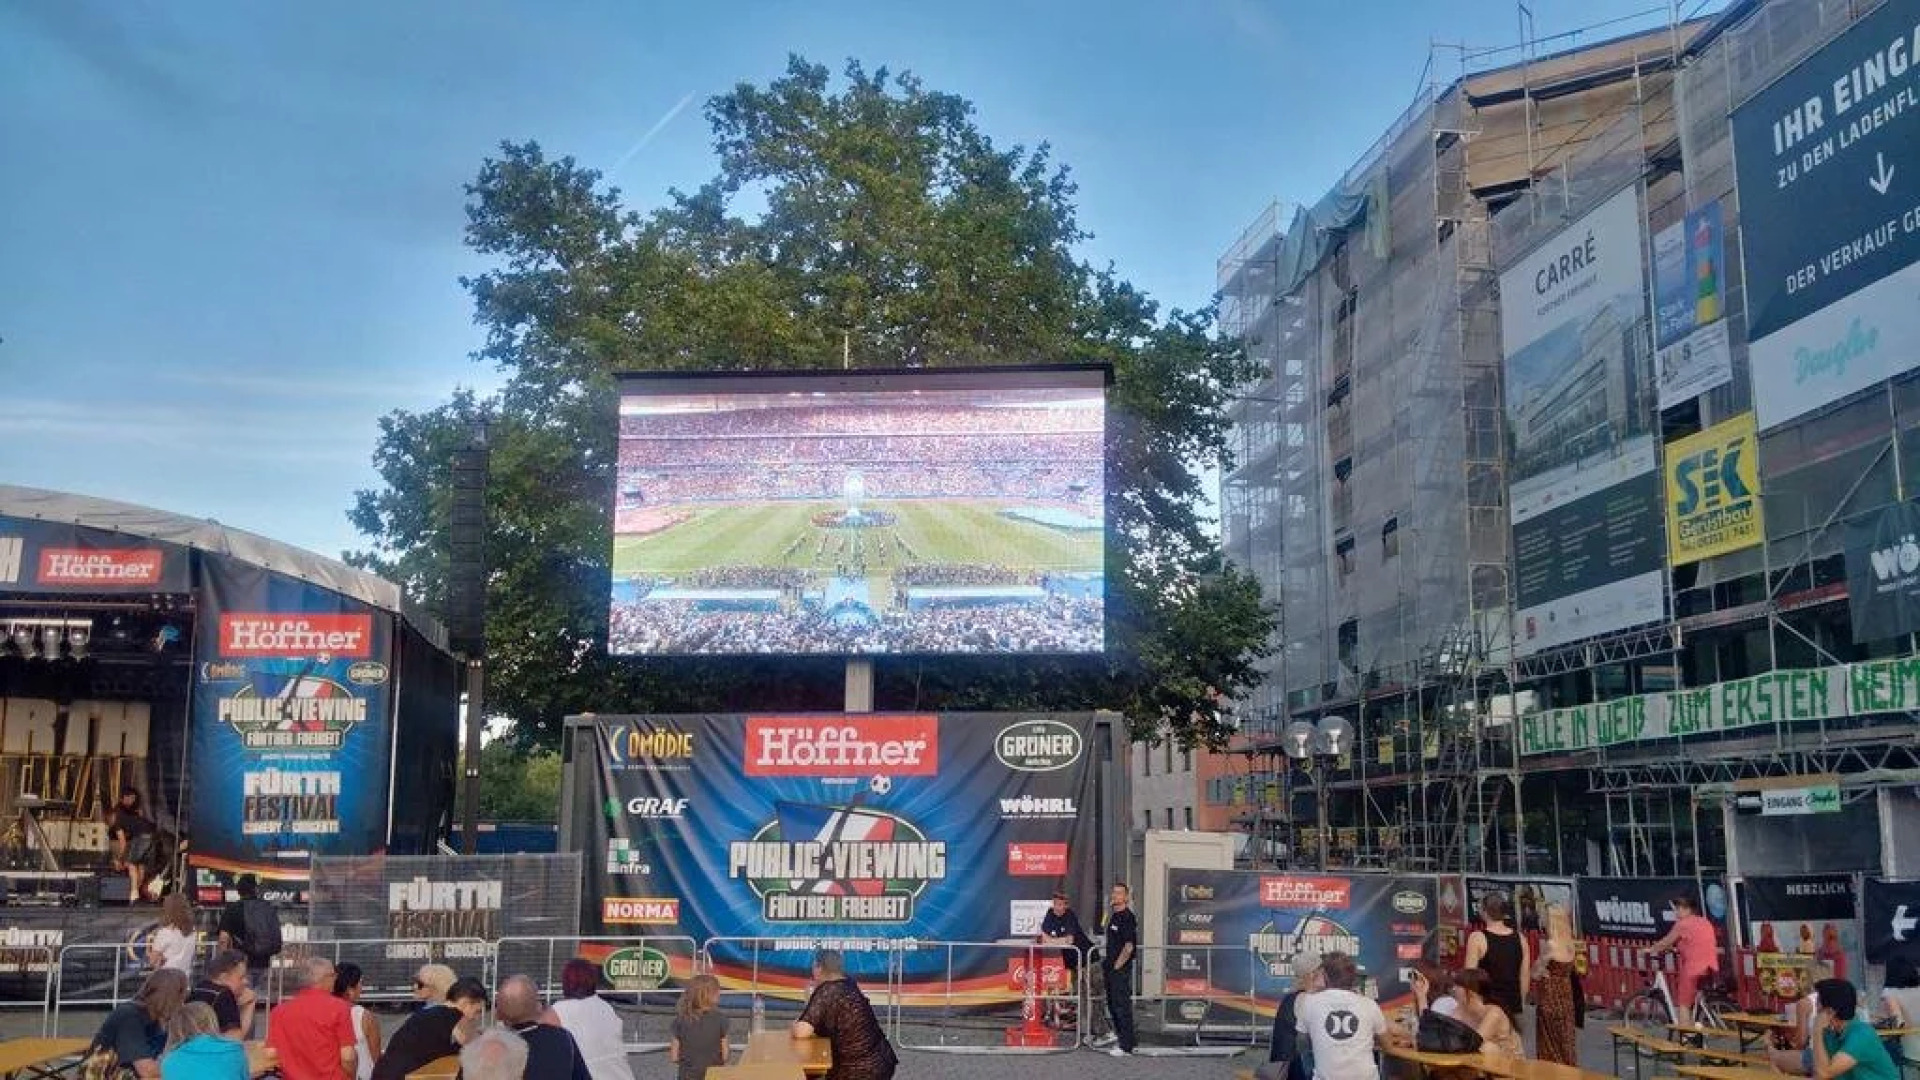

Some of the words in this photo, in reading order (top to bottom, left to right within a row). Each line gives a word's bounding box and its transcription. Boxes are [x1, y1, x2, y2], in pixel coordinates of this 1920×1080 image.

[1773, 96, 1824, 155] IHR
[1778, 161, 1798, 190] ZU
[1802, 137, 1834, 173] DEN
[1535, 229, 1597, 295] CARRÉ
[1787, 263, 1816, 295] DER
[1820, 220, 1897, 276] VERKAUF
[47, 554, 154, 579] Höffner
[229, 619, 361, 650] Höffner
[218, 698, 284, 721] PUBLIC
[293, 698, 367, 721] VIEWING
[1521, 711, 1564, 751] ALLE
[1573, 705, 1588, 747] IN
[1666, 688, 1712, 734] ZUM
[1722, 671, 1829, 727] ERSTEN
[756, 726, 927, 766] Höffner
[243, 767, 341, 795] FÜRTH
[244, 795, 337, 821] FESTIVAL
[627, 798, 690, 815] GRAF
[1000, 794, 1077, 813] WÖHRL
[729, 841, 821, 878] PUBLIC
[832, 841, 947, 880] VIEWING
[389, 876, 502, 910] FÜRTH
[1265, 882, 1345, 903] Höffner
[1786, 882, 1846, 895] HERZLICH
[606, 902, 674, 918] NORMA
[769, 893, 835, 919] FÜRTHER
[841, 895, 907, 919] FREIHEIT
[1594, 895, 1655, 925] WÖHRL
